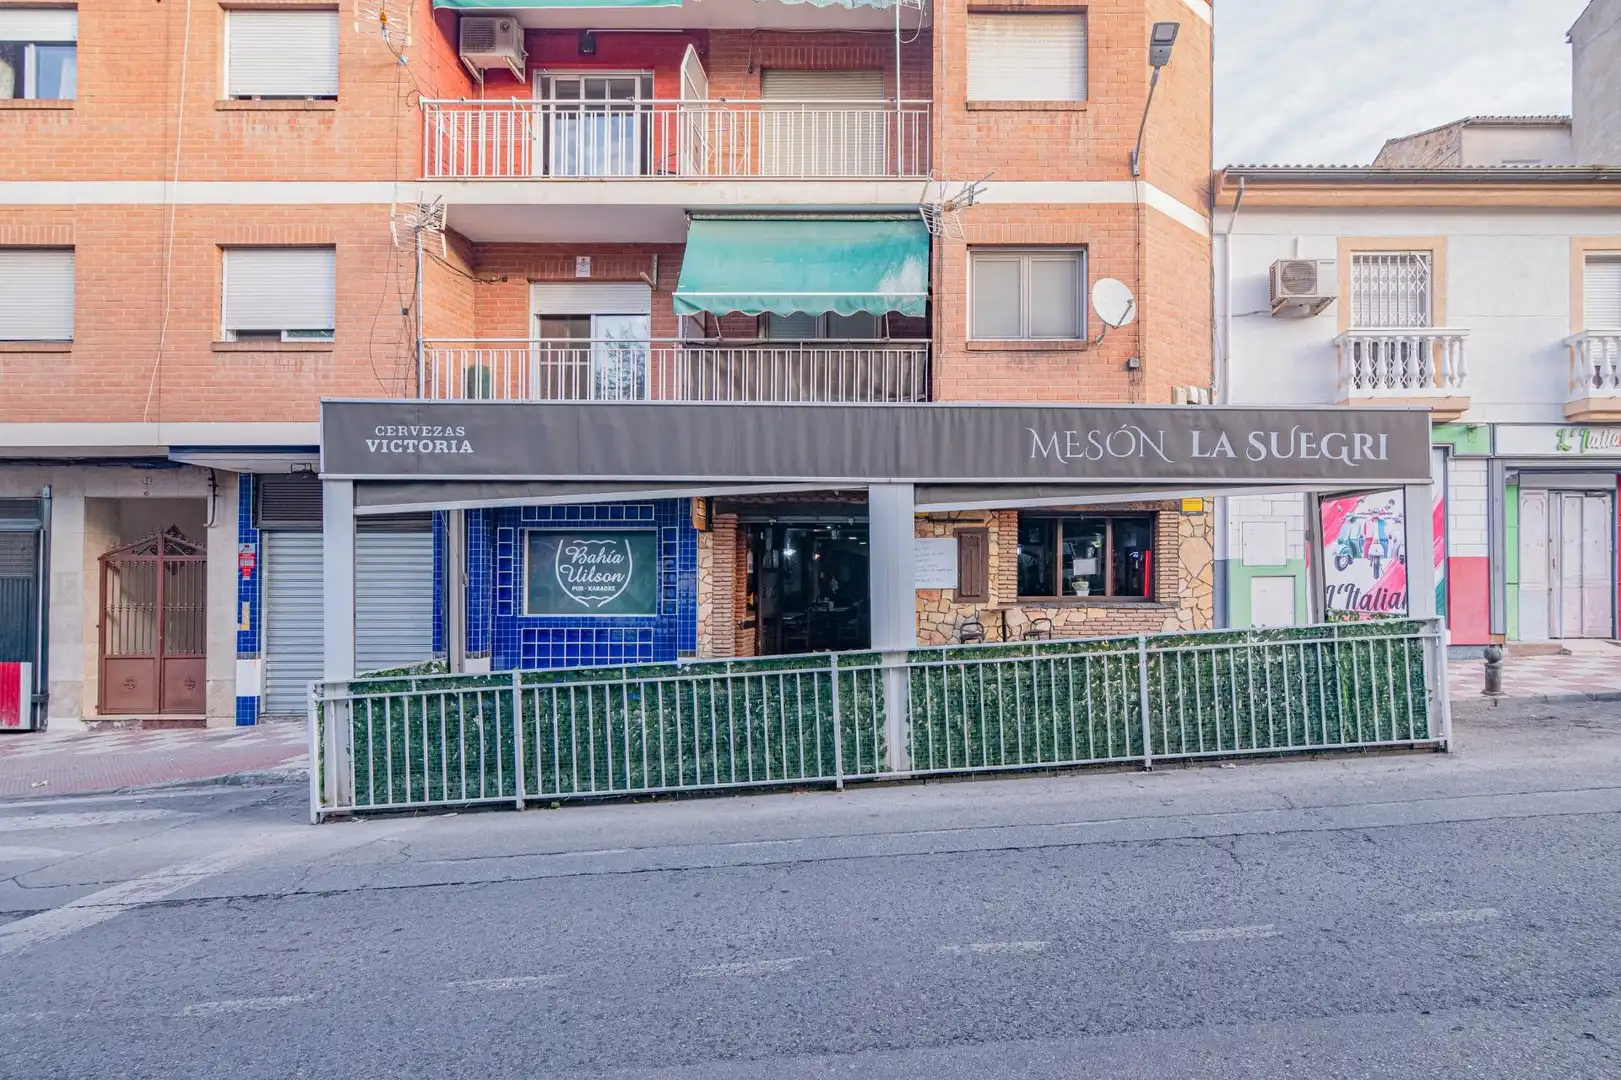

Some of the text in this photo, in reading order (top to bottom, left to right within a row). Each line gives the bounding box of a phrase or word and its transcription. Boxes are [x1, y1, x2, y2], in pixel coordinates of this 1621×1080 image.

[375, 425, 466, 437] CERVEZAS
[365, 439, 474, 453] VICTORIA
[1025, 424, 1389, 467] MESÓN LA SUEGRI
[565, 545, 625, 564] Bahía
